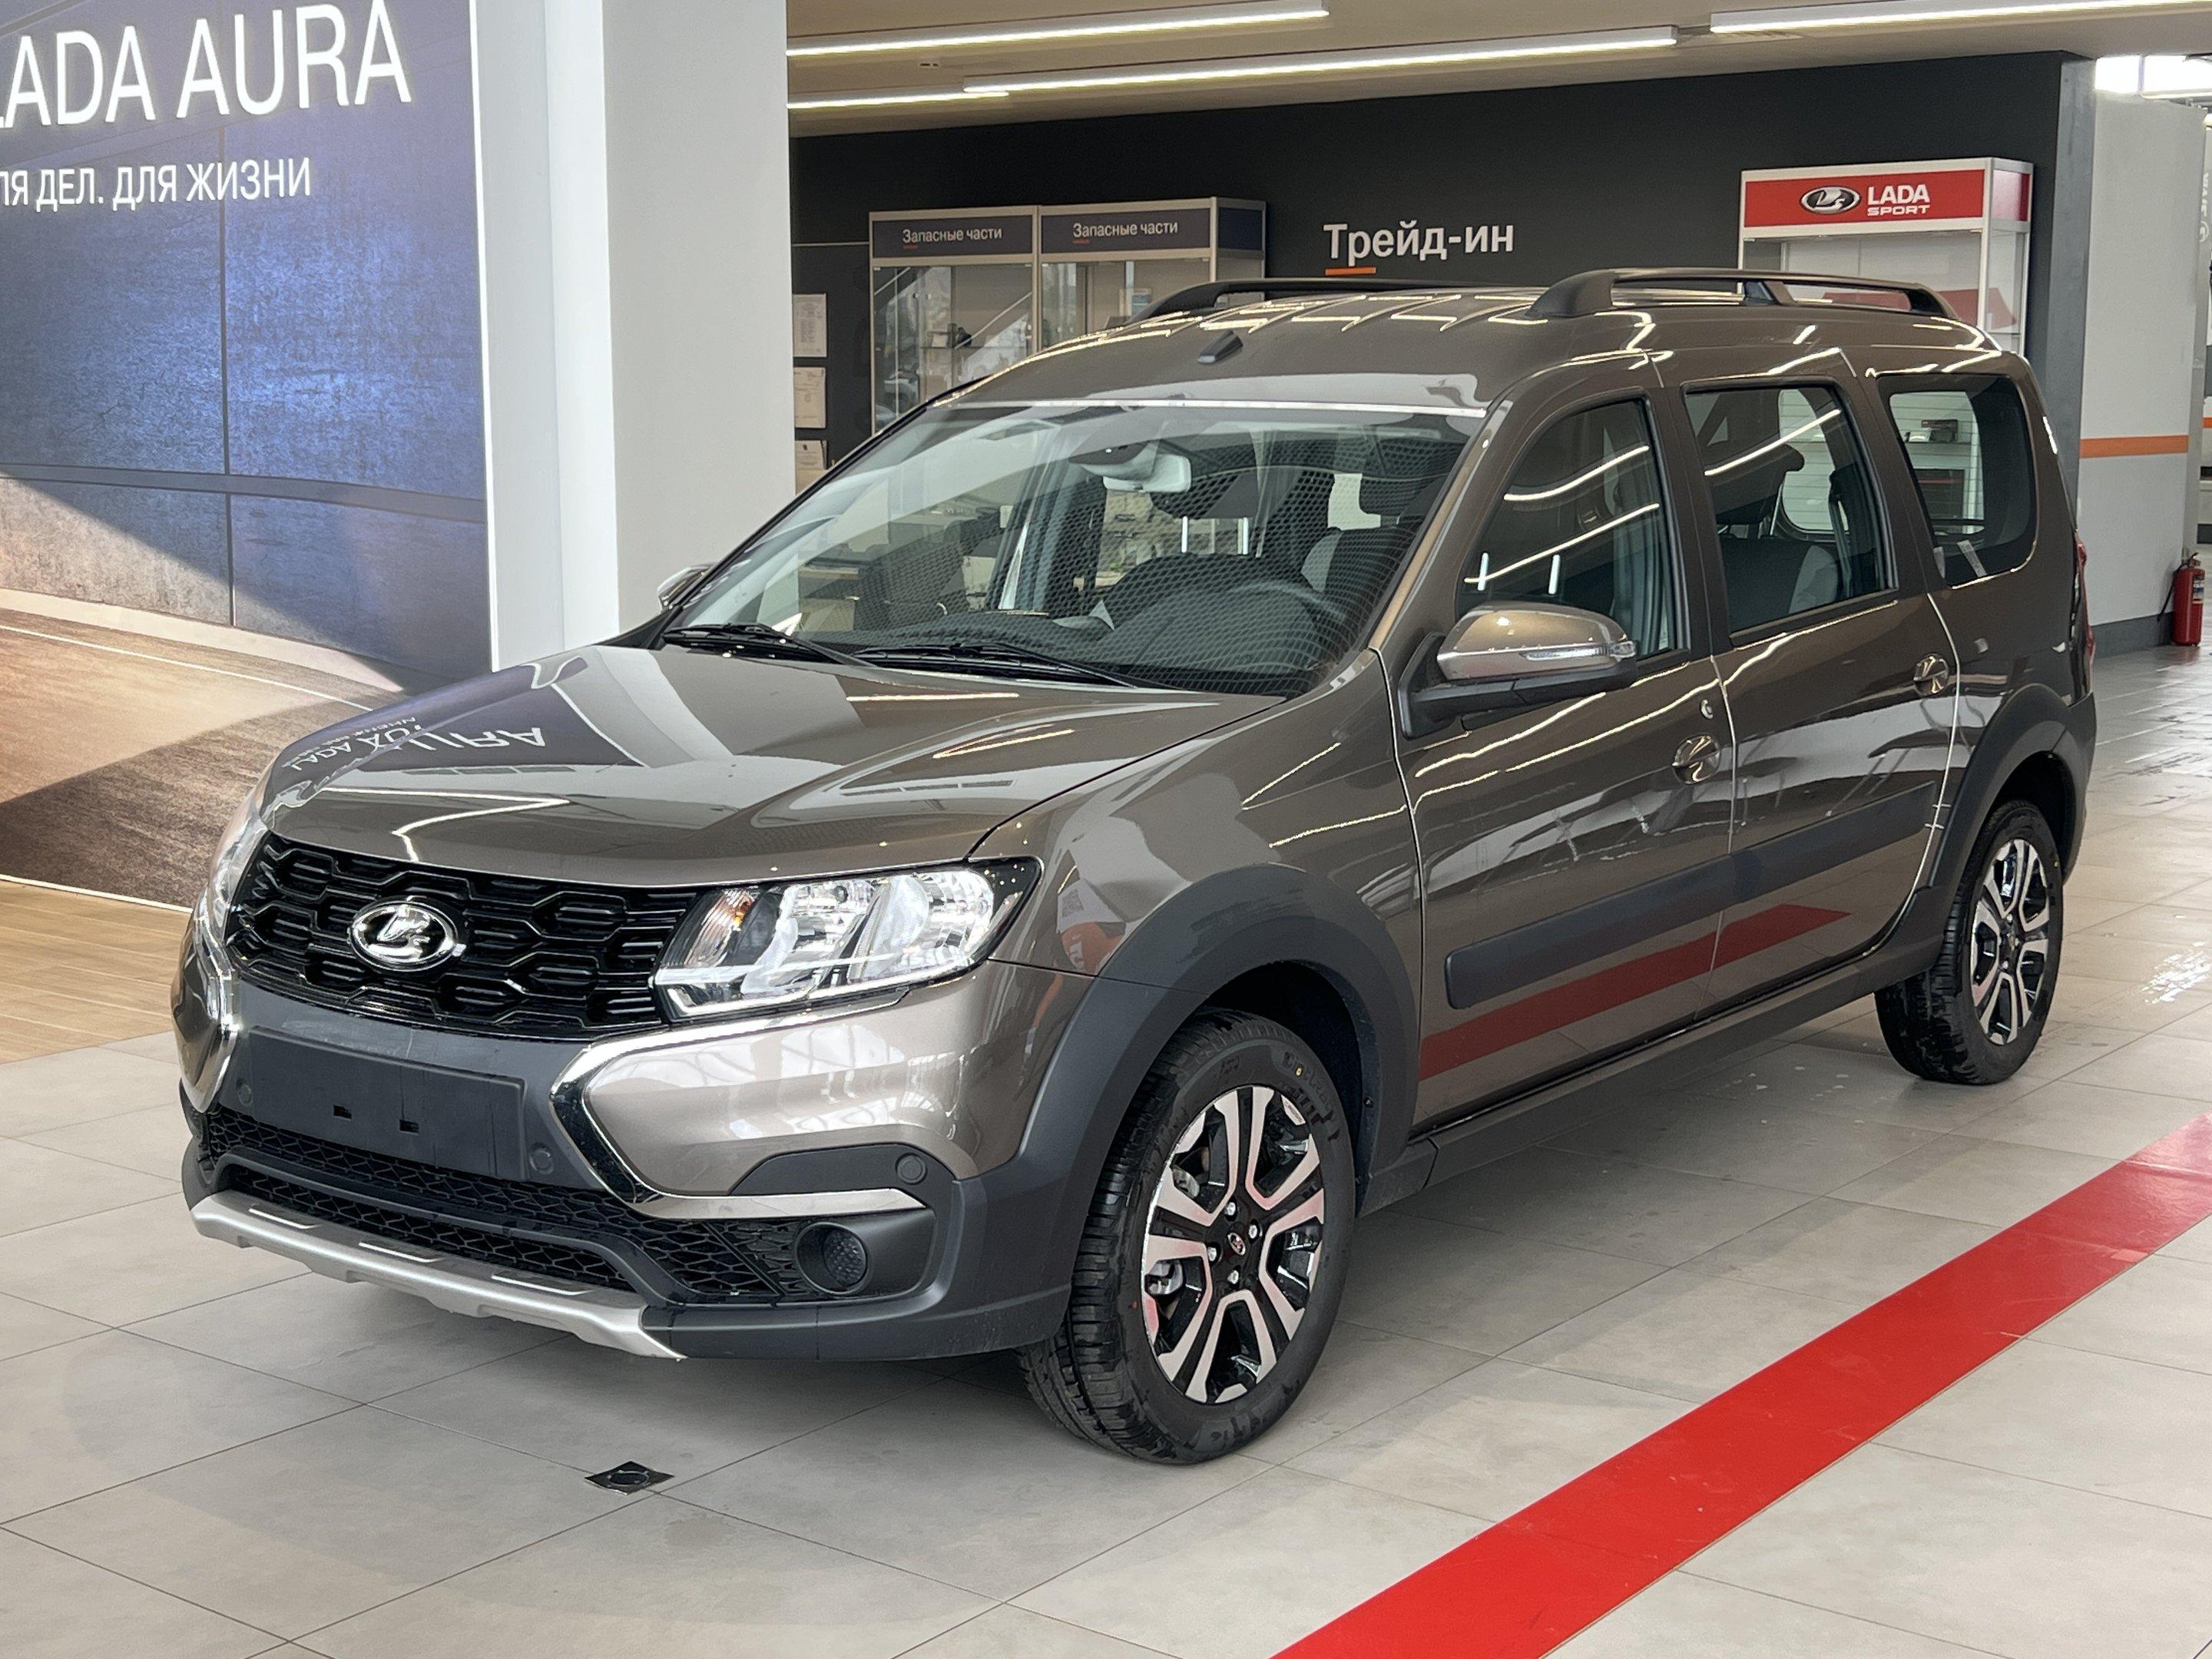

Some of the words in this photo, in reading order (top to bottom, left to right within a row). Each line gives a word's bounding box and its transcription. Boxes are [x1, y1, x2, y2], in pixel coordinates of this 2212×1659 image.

[0, 25, 156, 128] ADA
[176, 0, 412, 119] AURA
[35, 167, 104, 212] ДЕЛ.
[112, 164, 177, 212] ДЛЯ
[186, 157, 311, 202] ЖИЗНИ
[1867, 184, 1930, 205] LADA
[1867, 204, 1931, 217] SPORT
[902, 229, 964, 243] Запасные
[966, 228, 1002, 240] части
[1073, 222, 1137, 238] Запасные
[1140, 222, 1178, 235] части
[1323, 219, 1514, 267] Трейд-ин
